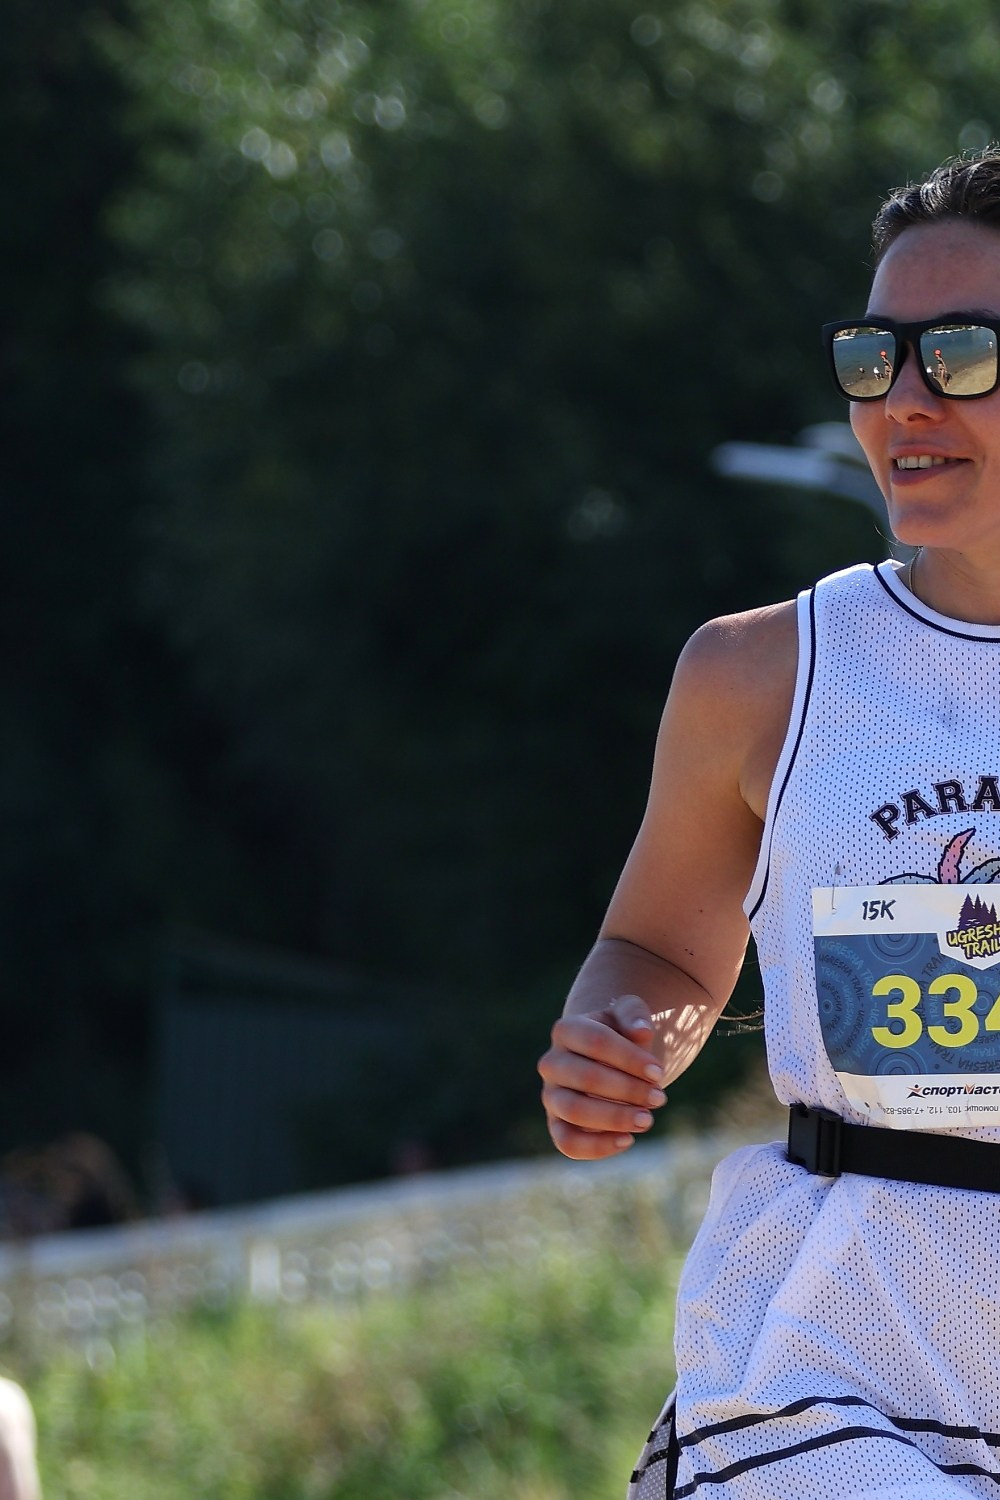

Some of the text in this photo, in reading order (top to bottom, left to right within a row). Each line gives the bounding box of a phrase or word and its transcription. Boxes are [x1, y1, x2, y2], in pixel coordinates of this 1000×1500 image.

[862, 900, 897, 921] 15K
[927, 1107, 943, 1115] 112,
[946, 1106, 962, 1114] 103,
